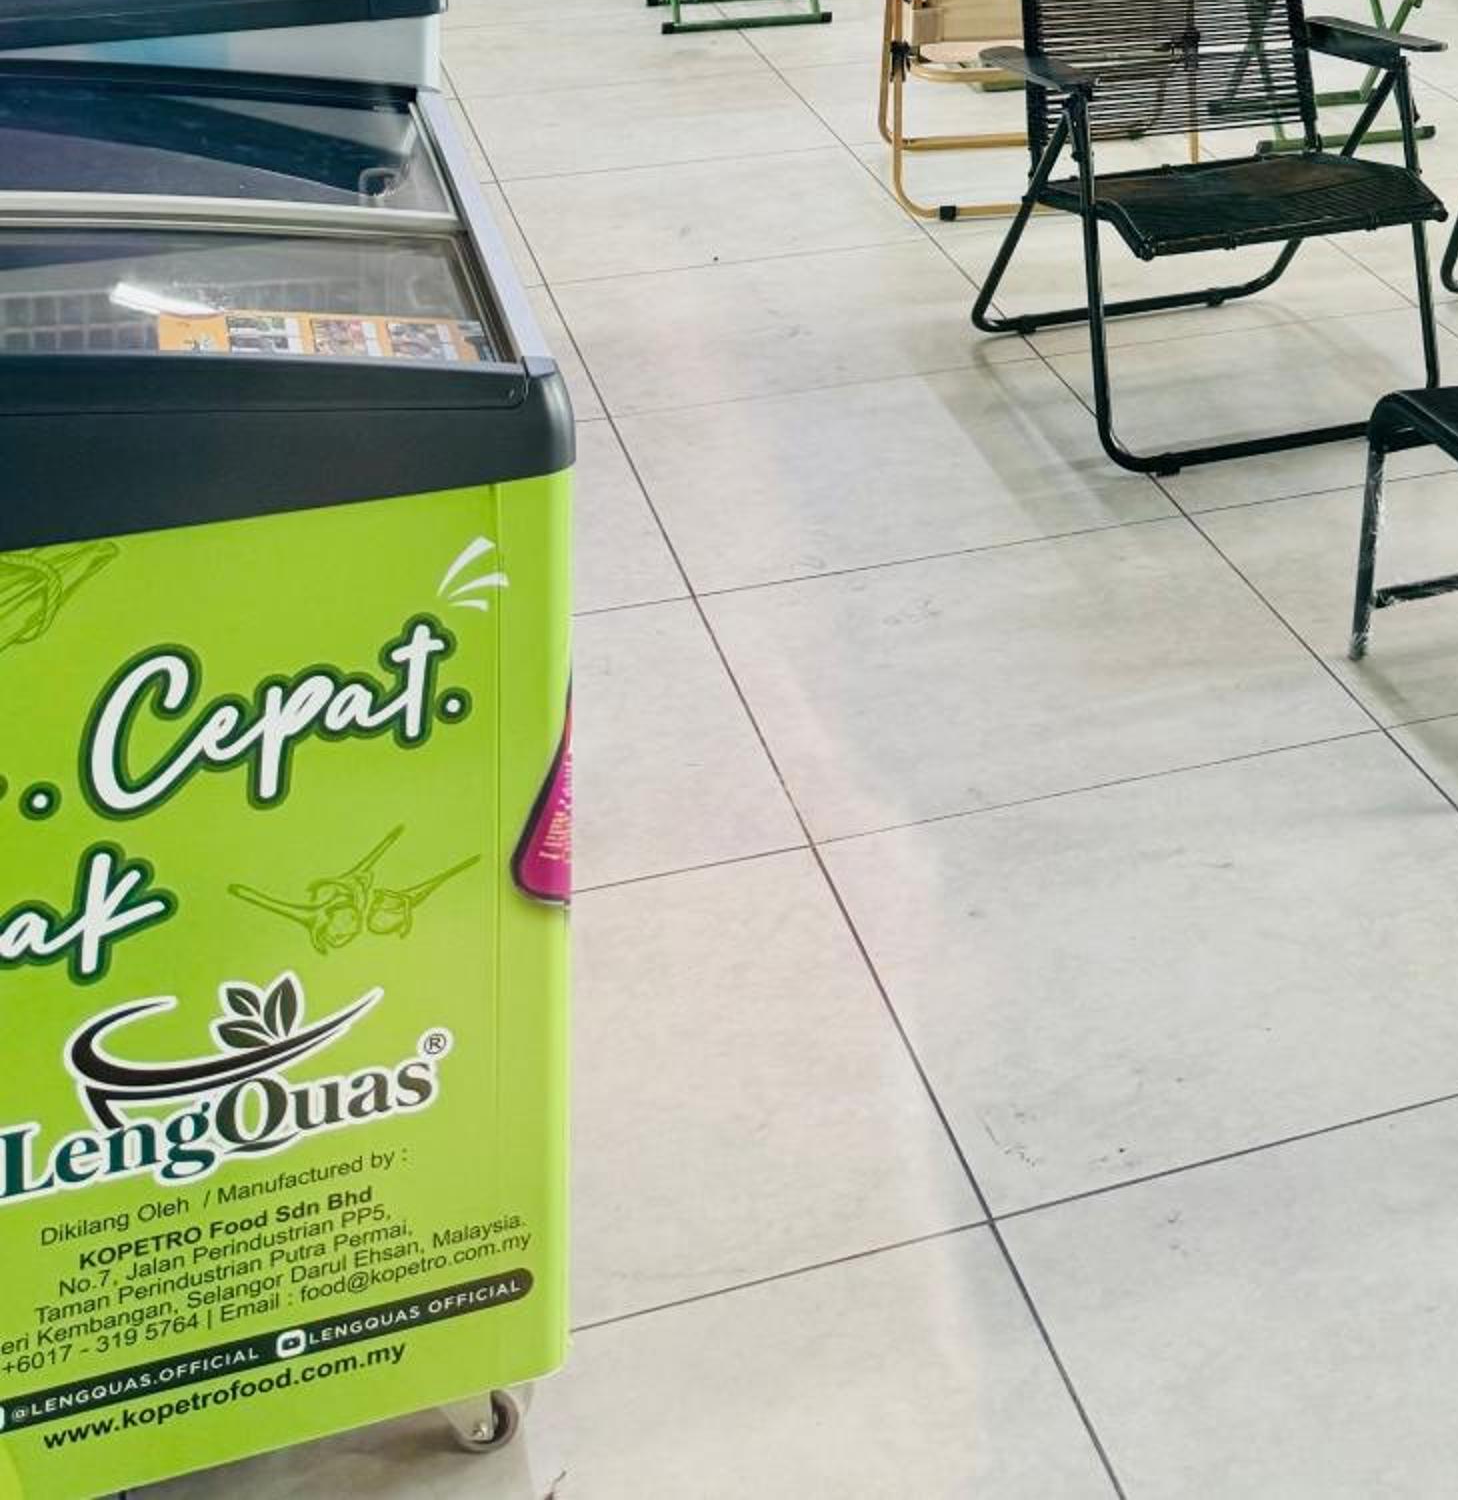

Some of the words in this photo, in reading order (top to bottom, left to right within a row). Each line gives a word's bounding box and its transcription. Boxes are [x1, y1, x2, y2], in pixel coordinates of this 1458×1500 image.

[91, 623, 461, 810] Cepat.
[0, 1060, 434, 1198] LengQuas
[41, 1213, 130, 1246] Dikilang
[138, 1199, 189, 1222] Oleh
[217, 1156, 363, 1204] Manufactured
[371, 1151, 395, 1170] by
[79, 1227, 201, 1270] KOPETRO
[210, 1211, 268, 1239] Food
[275, 1202, 319, 1223] Sdn
[327, 1186, 373, 1210] Bhd
[35, 1295, 110, 1325] Taman
[119, 1260, 262, 1304] Perindustrian
[270, 1242, 326, 1267] Putra
[126, 1255, 185, 1281] Jalan
[193, 1219, 333, 1265] Perindustrian
[187, 1273, 284, 1309] Selangor
[291, 1257, 347, 1283] Darul
[2, 1345, 72, 1374] +6017
[96, 1329, 138, 1353] 319
[145, 1313, 200, 1341] 5764
[220, 1293, 279, 1322] Email
[301, 1233, 532, 1302] food@kopetro.com.my
[12, 1347, 260, 1420] @LENGQUAS.OFFICIAL
[309, 1305, 420, 1345] LENGQUAS
[428, 1280, 522, 1314] OFFICIAL
[43, 1343, 406, 1449] www.kopetrofood.com.my
